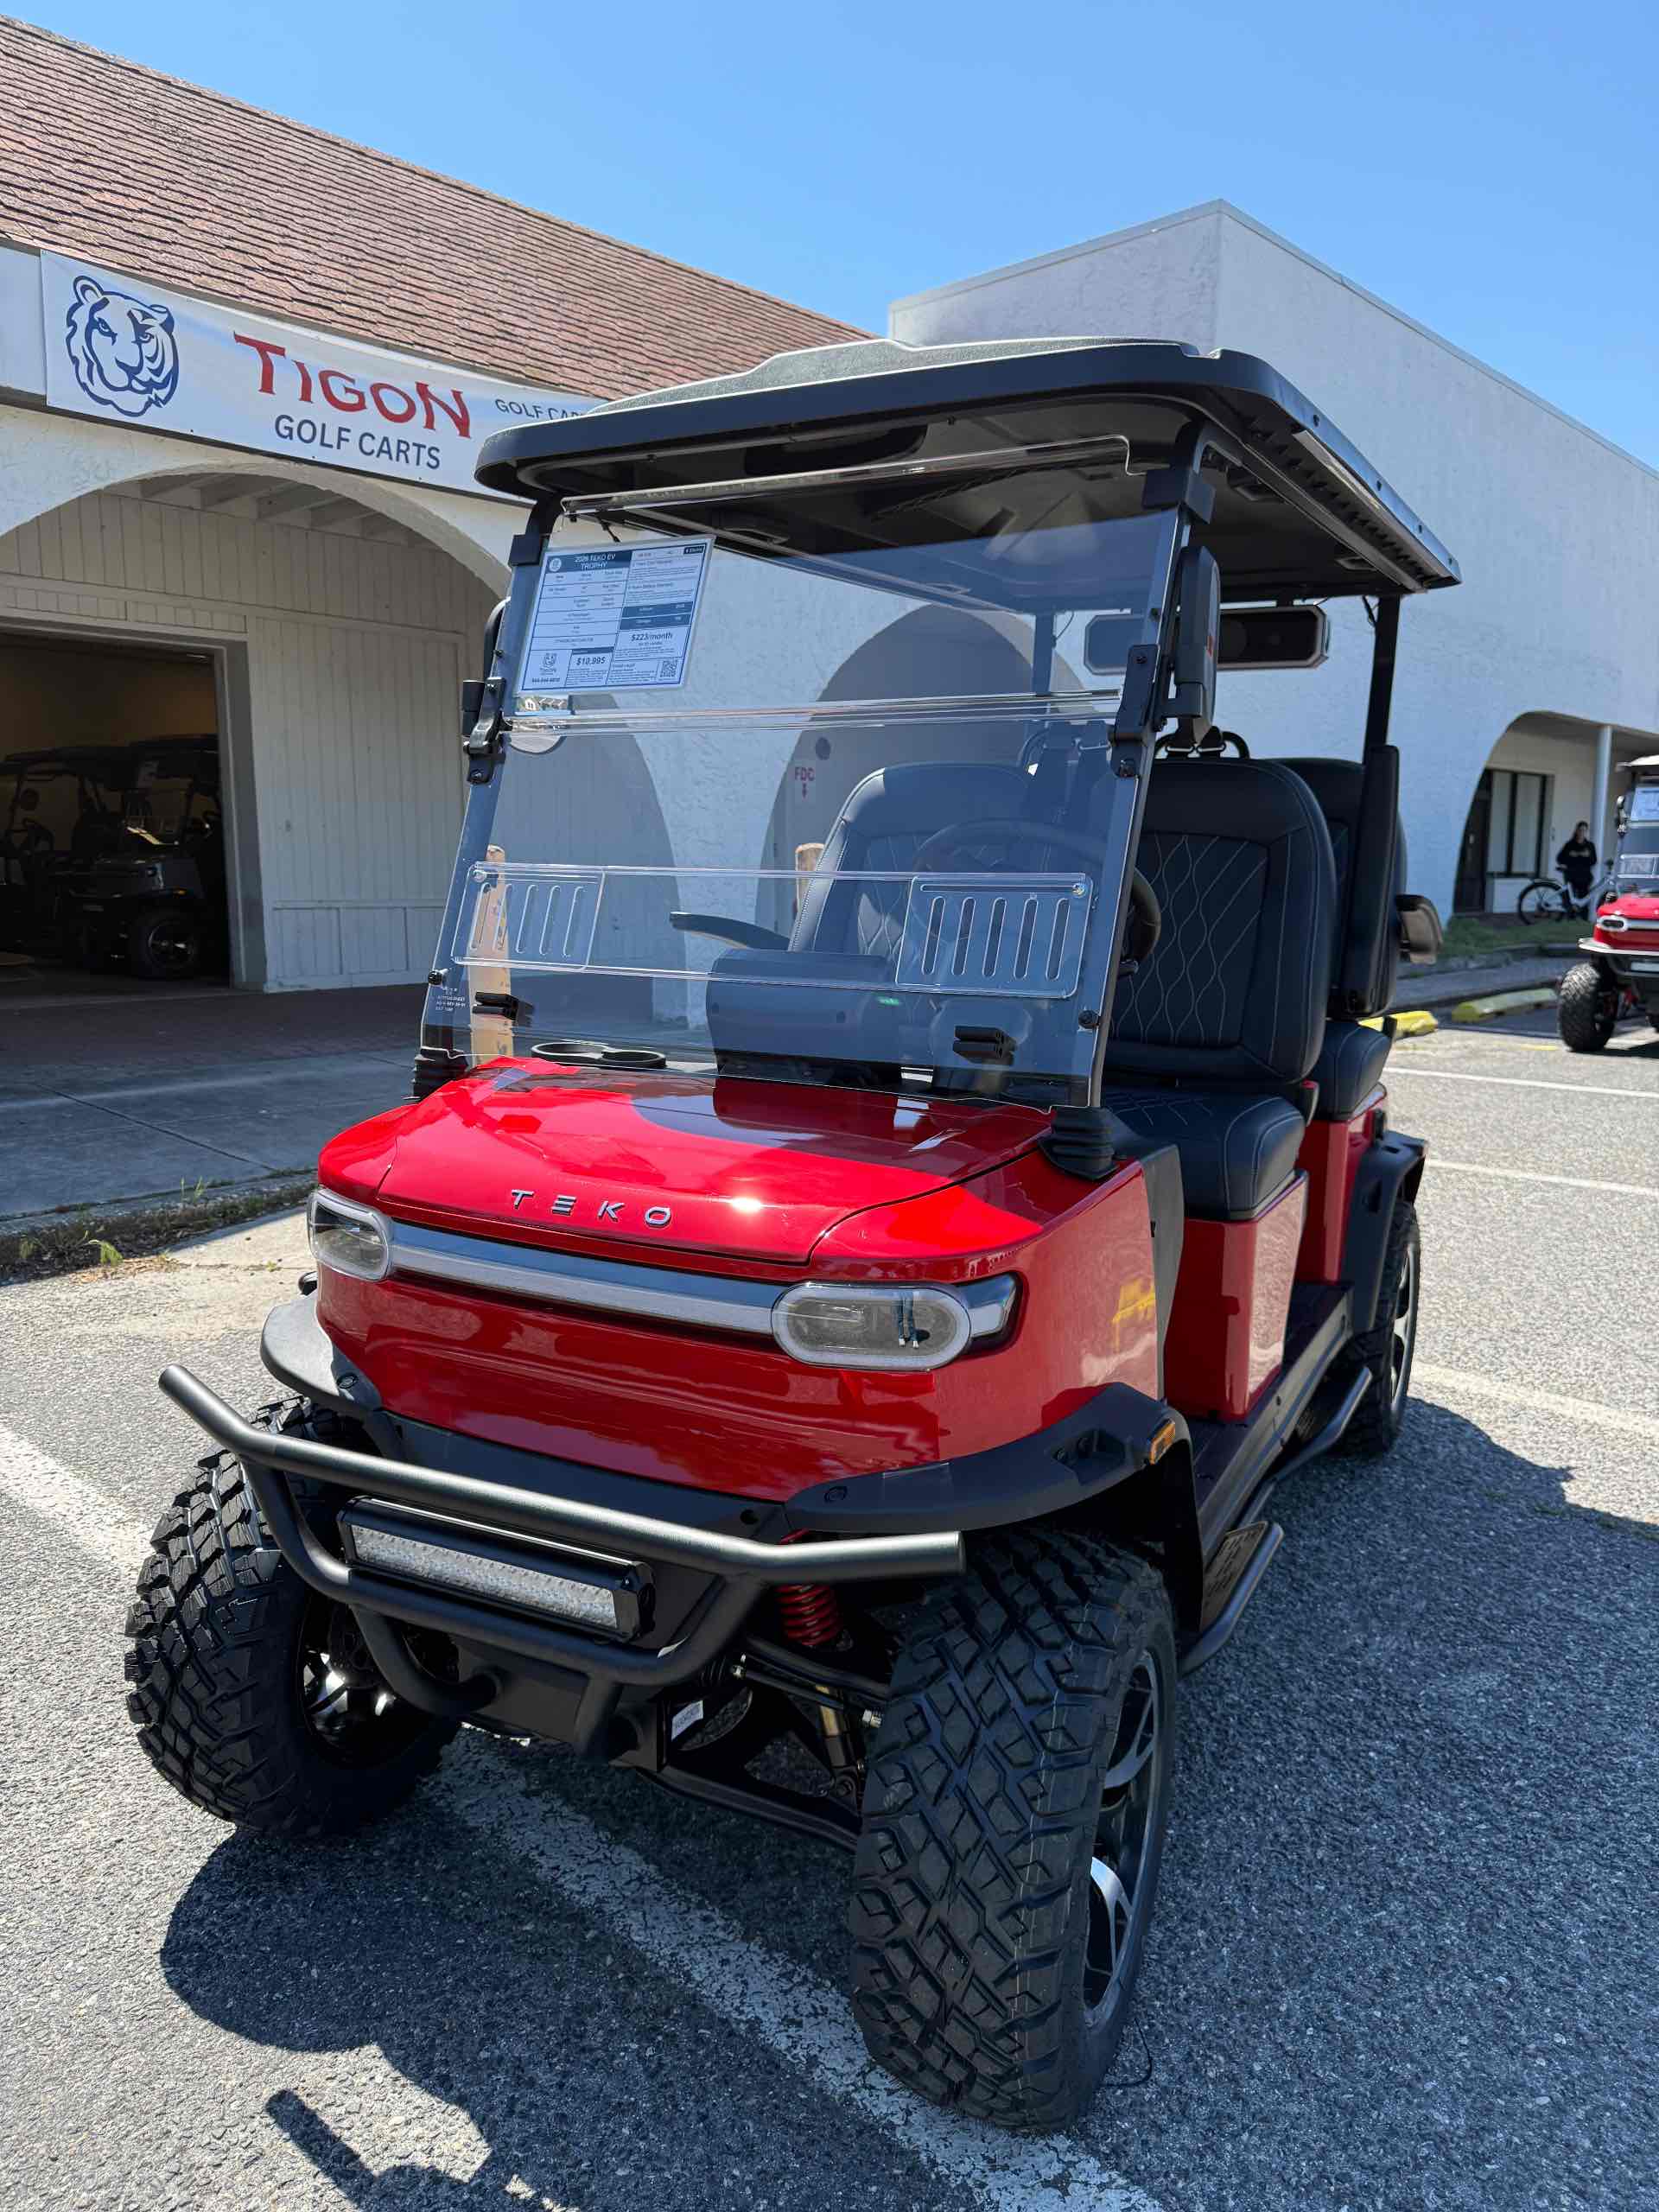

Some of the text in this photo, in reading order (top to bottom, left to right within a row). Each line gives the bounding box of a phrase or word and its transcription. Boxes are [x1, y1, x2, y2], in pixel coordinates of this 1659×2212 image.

[233, 331, 471, 439] TIGON
[494, 398, 543, 419] GOLF
[274, 414, 441, 469] GOLF CARTS
[581, 561, 608, 570] TROPHY
[511, 1188, 672, 1228] TEKO
